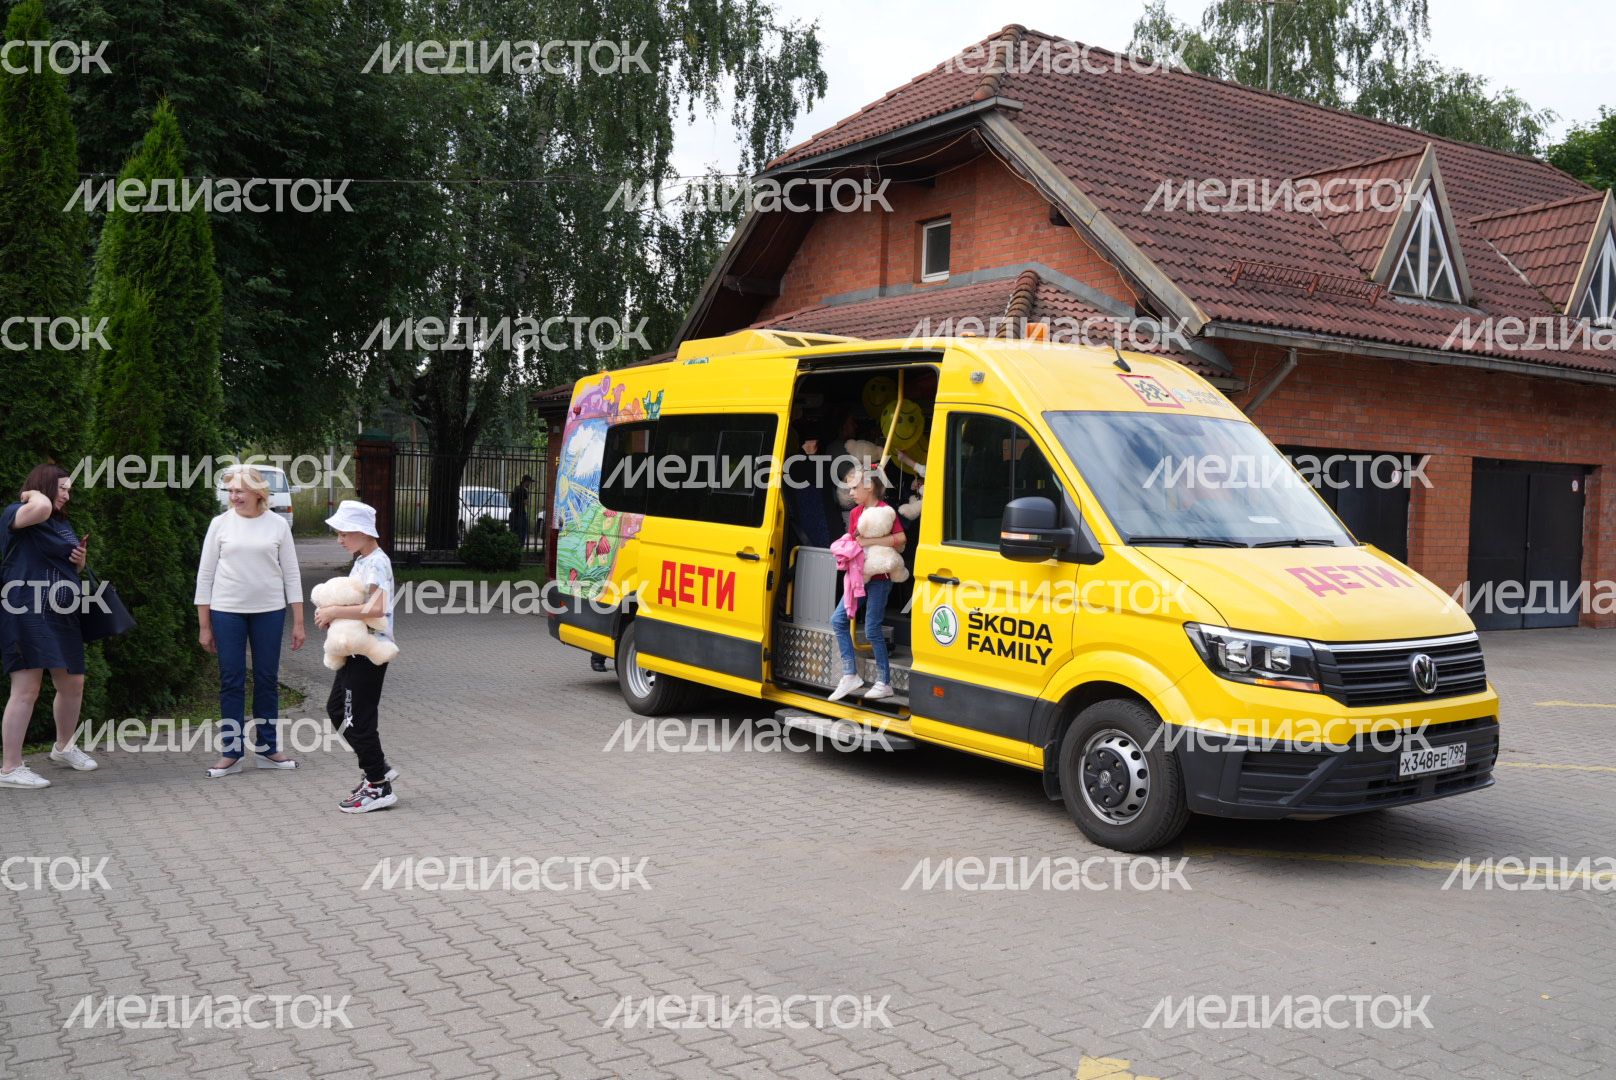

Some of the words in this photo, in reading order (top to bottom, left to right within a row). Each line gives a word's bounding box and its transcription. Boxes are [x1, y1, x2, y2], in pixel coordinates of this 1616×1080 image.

[658, 560, 736, 612] ДЕТИ
[1284, 565, 1413, 597] ДЕТИ
[968, 607, 1053, 644] ŠKODA
[967, 632, 1053, 666] FAMILY
[1449, 744, 1464, 760] 799
